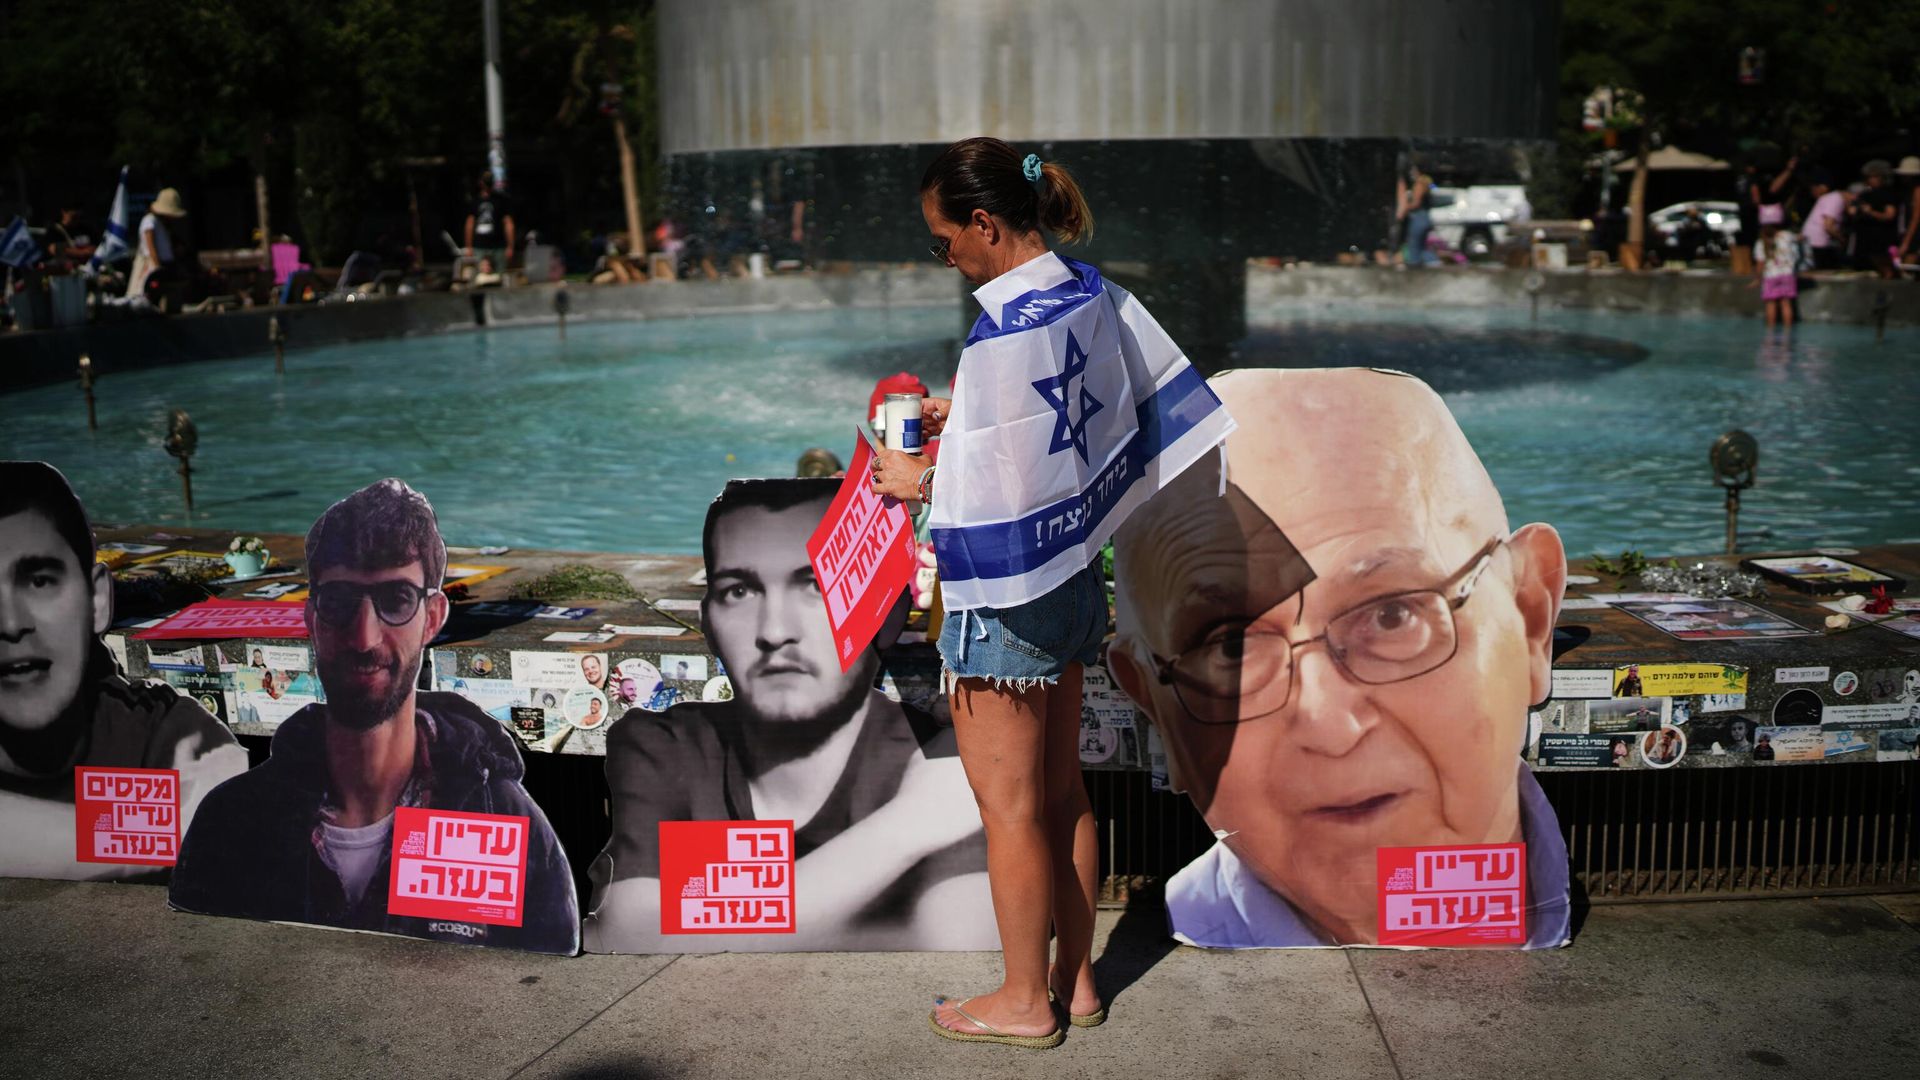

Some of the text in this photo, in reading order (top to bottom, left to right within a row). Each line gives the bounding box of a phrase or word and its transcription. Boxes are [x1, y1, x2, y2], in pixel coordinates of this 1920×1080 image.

[1098, 455, 1127, 502] ביחד
[821, 491, 867, 575] החטוף
[839, 507, 893, 611] האחרון
[1672, 672, 1696, 680] שלמה
[87, 776, 172, 802] מקסים
[117, 805, 173, 828] עדיין
[104, 834, 174, 856] בעזה.
[434, 821, 517, 856] עדיין
[736, 833, 784, 857] בר
[409, 865, 514, 902] בעזה.
[712, 865, 784, 893] עדיין
[1423, 853, 1515, 888] עדיין
[694, 900, 786, 924] בעזה.
[1399, 895, 1516, 926] בעזה.
